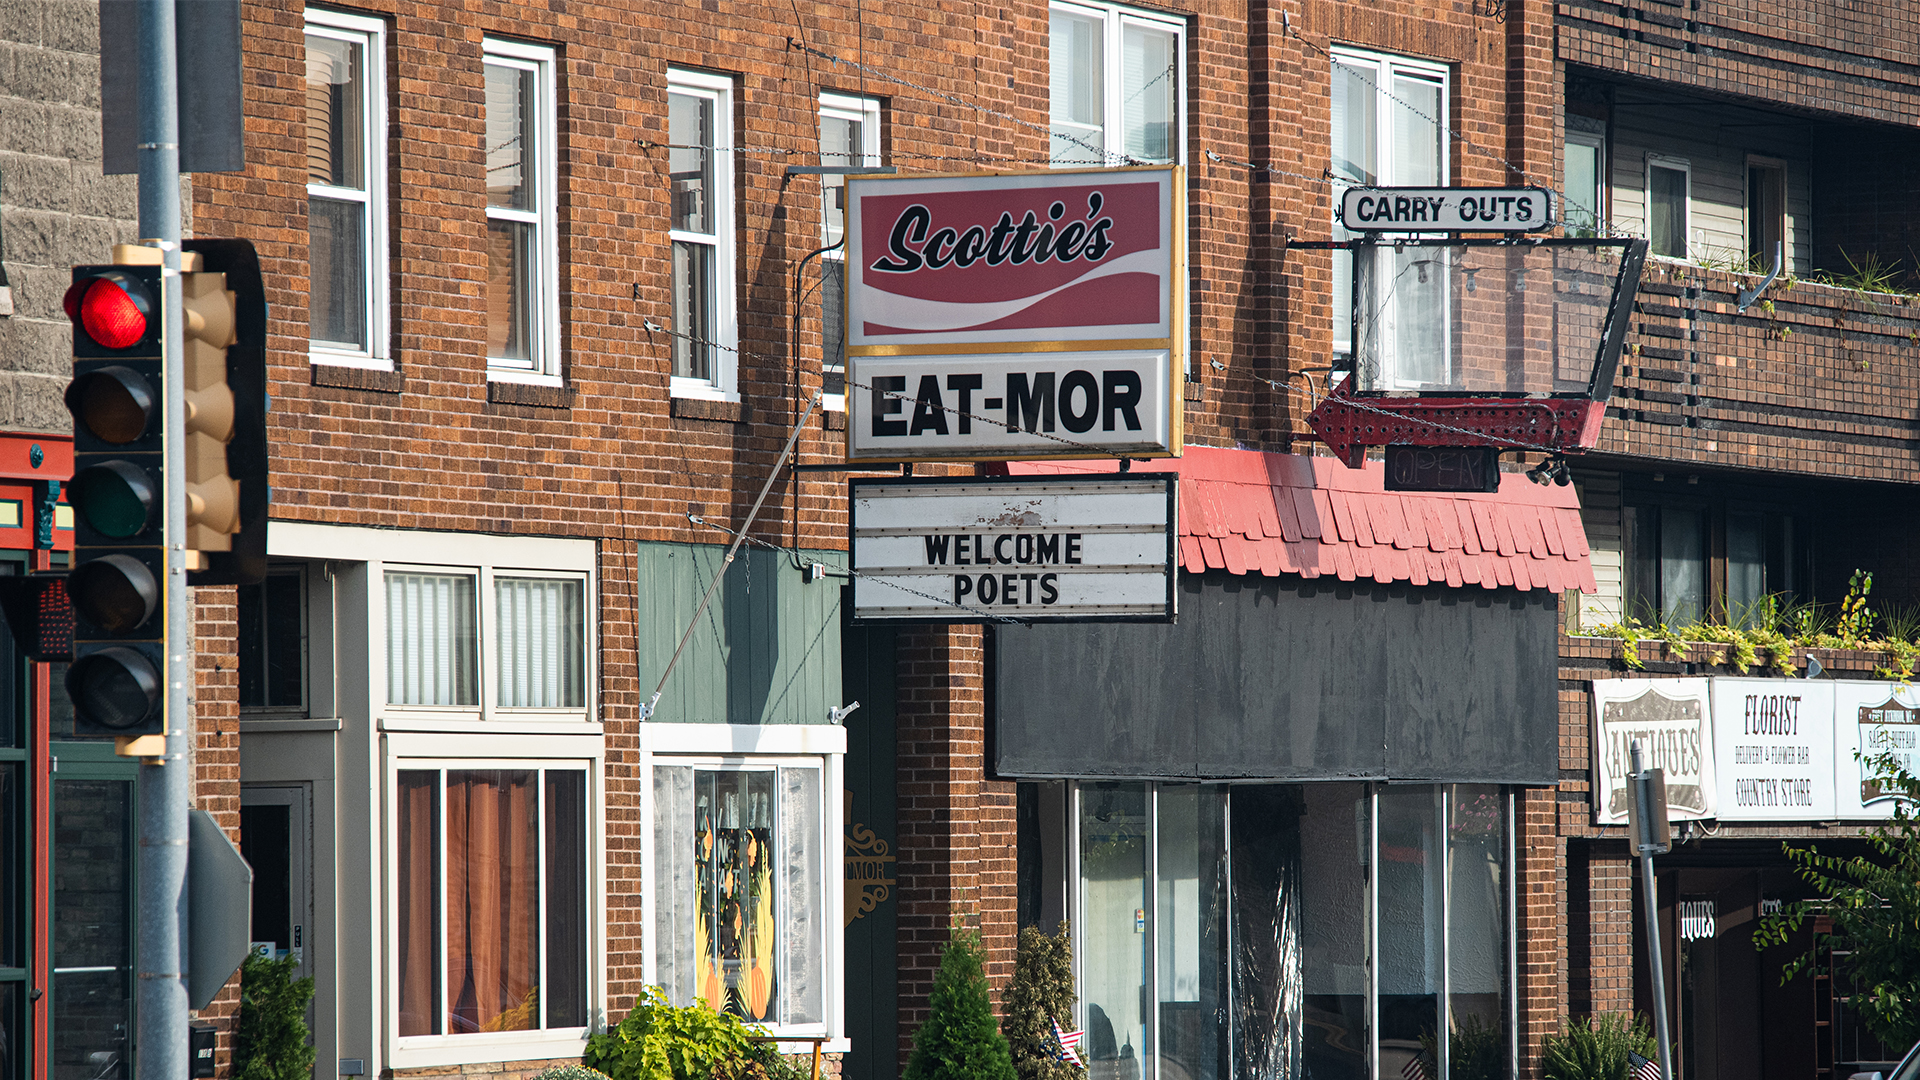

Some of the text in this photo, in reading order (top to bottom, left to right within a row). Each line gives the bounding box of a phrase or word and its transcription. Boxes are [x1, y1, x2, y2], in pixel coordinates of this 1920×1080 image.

[1357, 196, 1533, 222] CARRY OUTS
[870, 192, 1114, 273] Scottie's
[872, 369, 1142, 437] EAT-MOR
[1394, 450, 1484, 489] OPEN
[924, 533, 1082, 565] WELCOME
[954, 573, 1059, 605] POETS
[1745, 694, 1802, 736] FLORIST
[1735, 745, 1763, 765] DELIVERY
[1771, 745, 1796, 765] FLOWER
[1797, 745, 1810, 765] BAR
[1736, 778, 1813, 807] COUNTRY STORE
